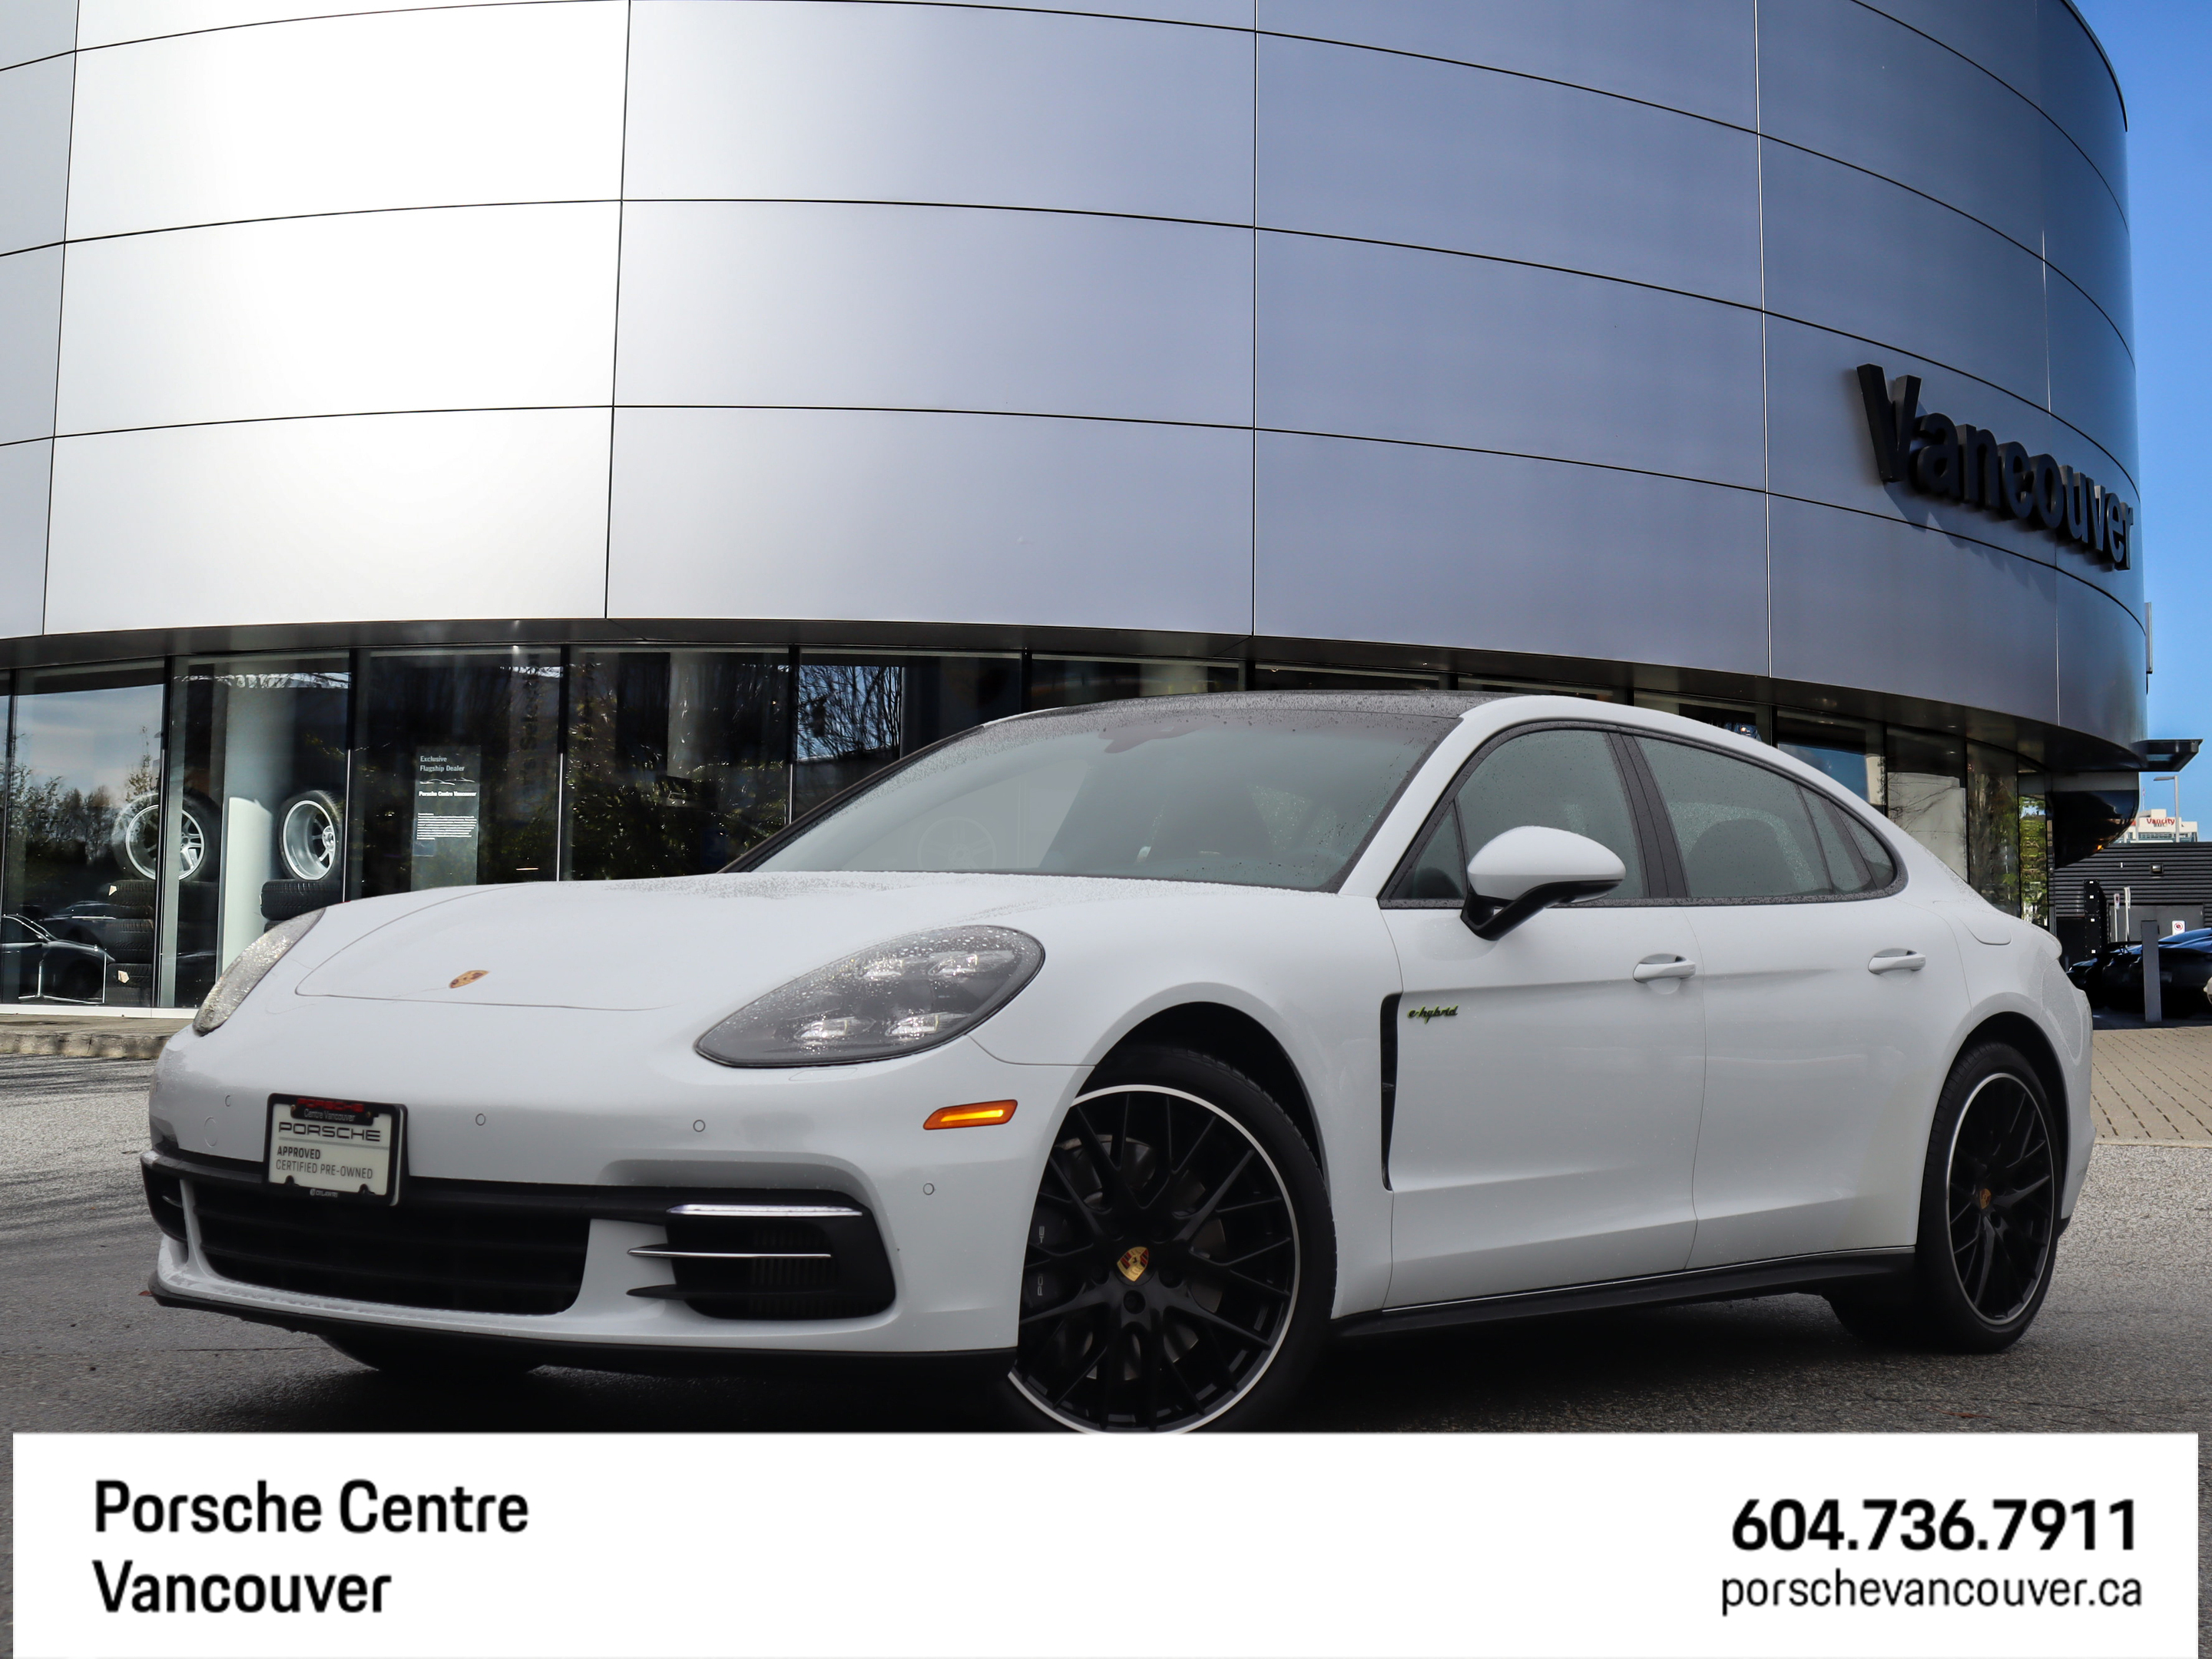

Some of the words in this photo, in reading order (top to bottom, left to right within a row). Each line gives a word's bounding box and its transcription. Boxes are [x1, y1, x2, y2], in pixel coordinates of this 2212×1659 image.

[1856, 363, 2134, 571] Vancouver
[1407, 1004, 1459, 1025] e-hybrid
[304, 1108, 323, 1119] Centre
[324, 1110, 356, 1121] Vancouver
[278, 1121, 381, 1142] PORSCHE
[276, 1146, 321, 1160] APPROVED
[276, 1159, 318, 1174] CERTIFIED
[320, 1164, 373, 1180] PRE-OWNED
